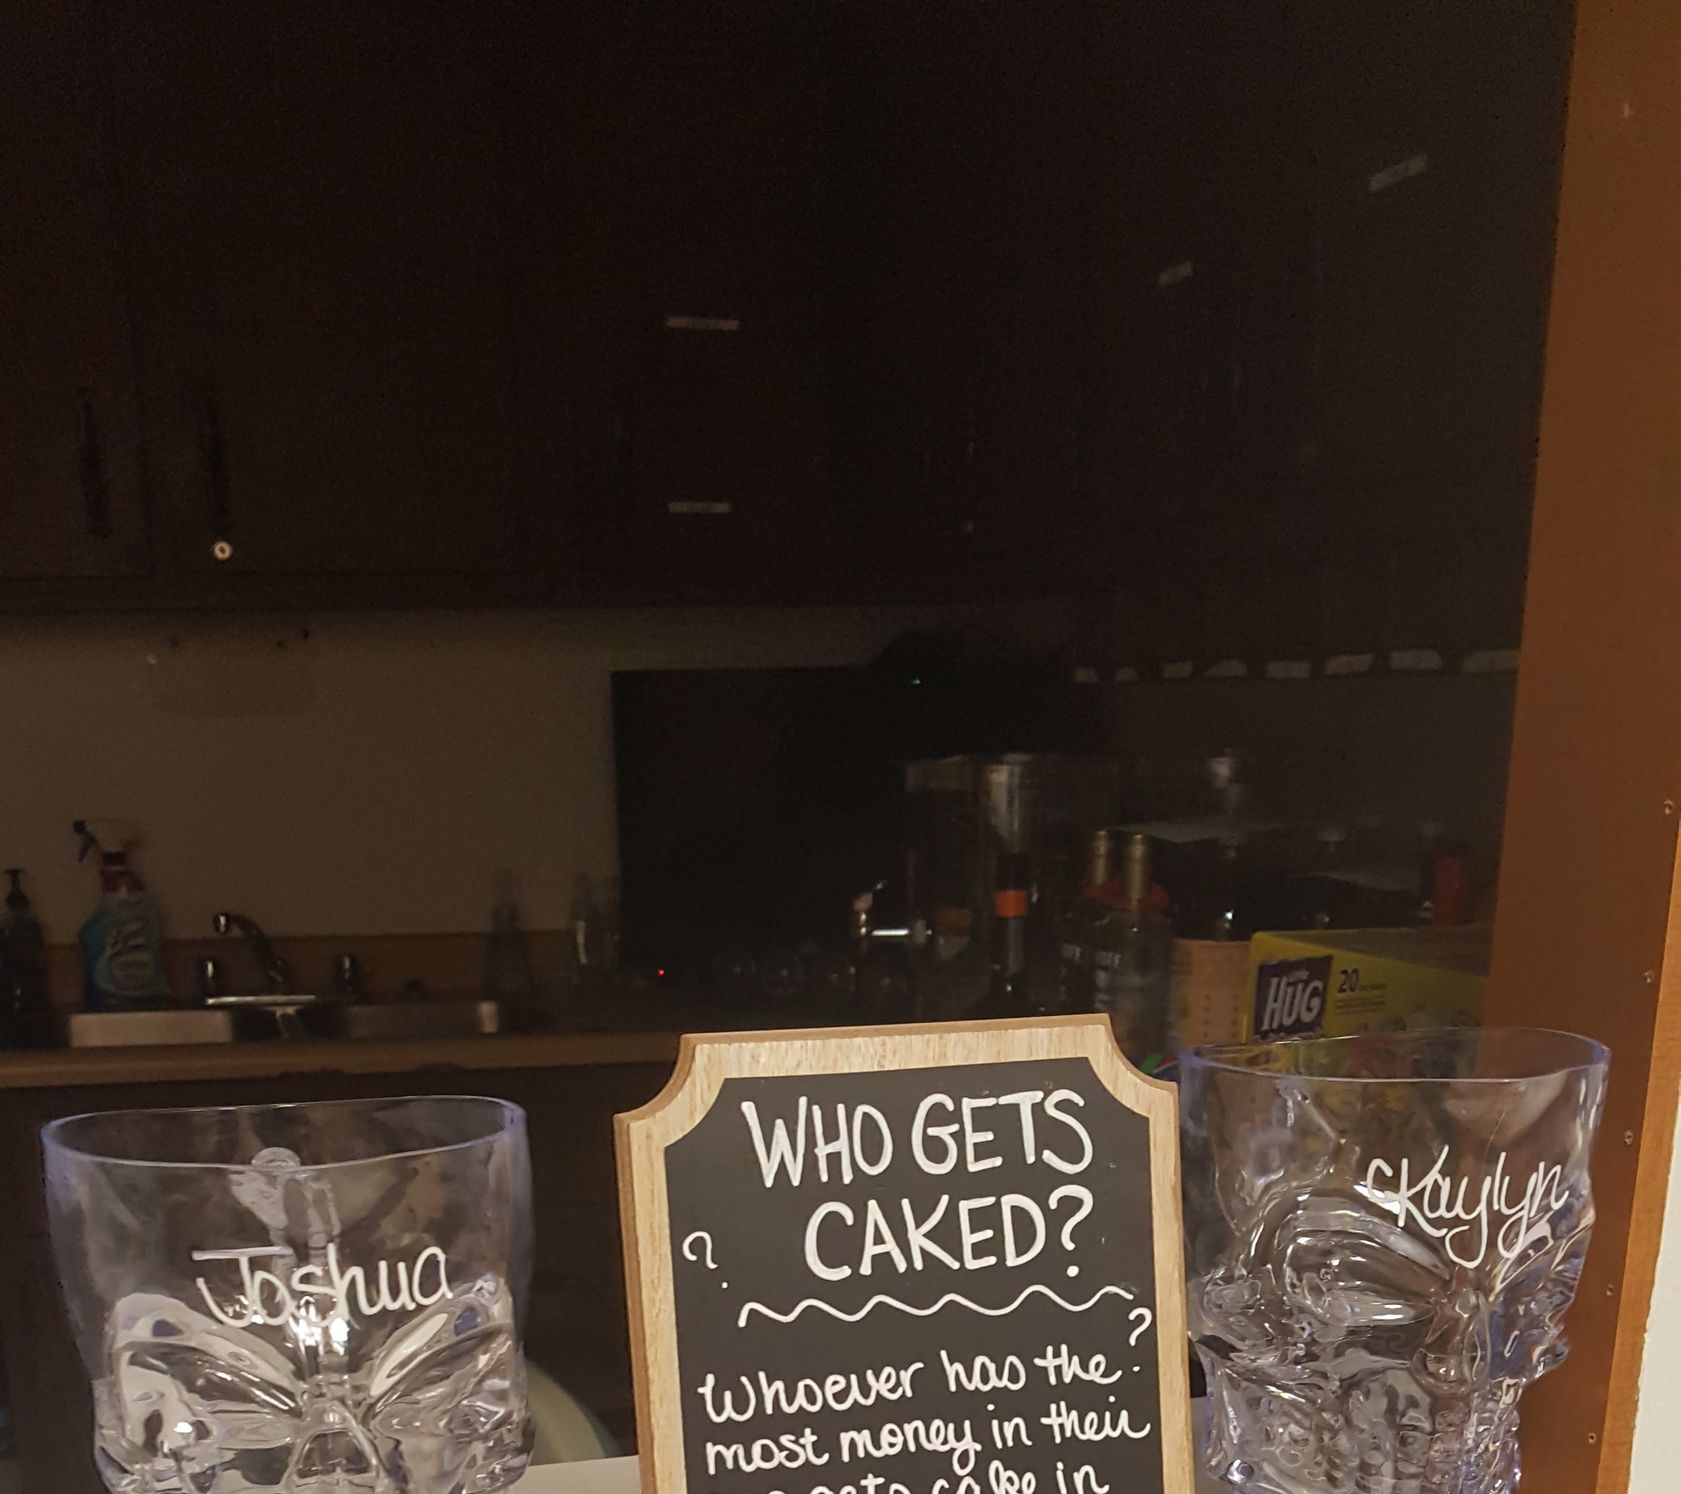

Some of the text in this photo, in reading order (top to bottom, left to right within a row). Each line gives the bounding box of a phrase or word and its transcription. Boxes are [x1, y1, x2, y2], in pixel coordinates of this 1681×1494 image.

[1261, 975, 1325, 1031] HUG
[1337, 967, 1361, 993] 20
[741, 1089, 1093, 1188] WHO GETS
[804, 1185, 1094, 1282] CAKED?
[191, 1241, 453, 1329] Joshua
[697, 1343, 1123, 1424] Whoever has the
[705, 1395, 1151, 1476] most money in their
